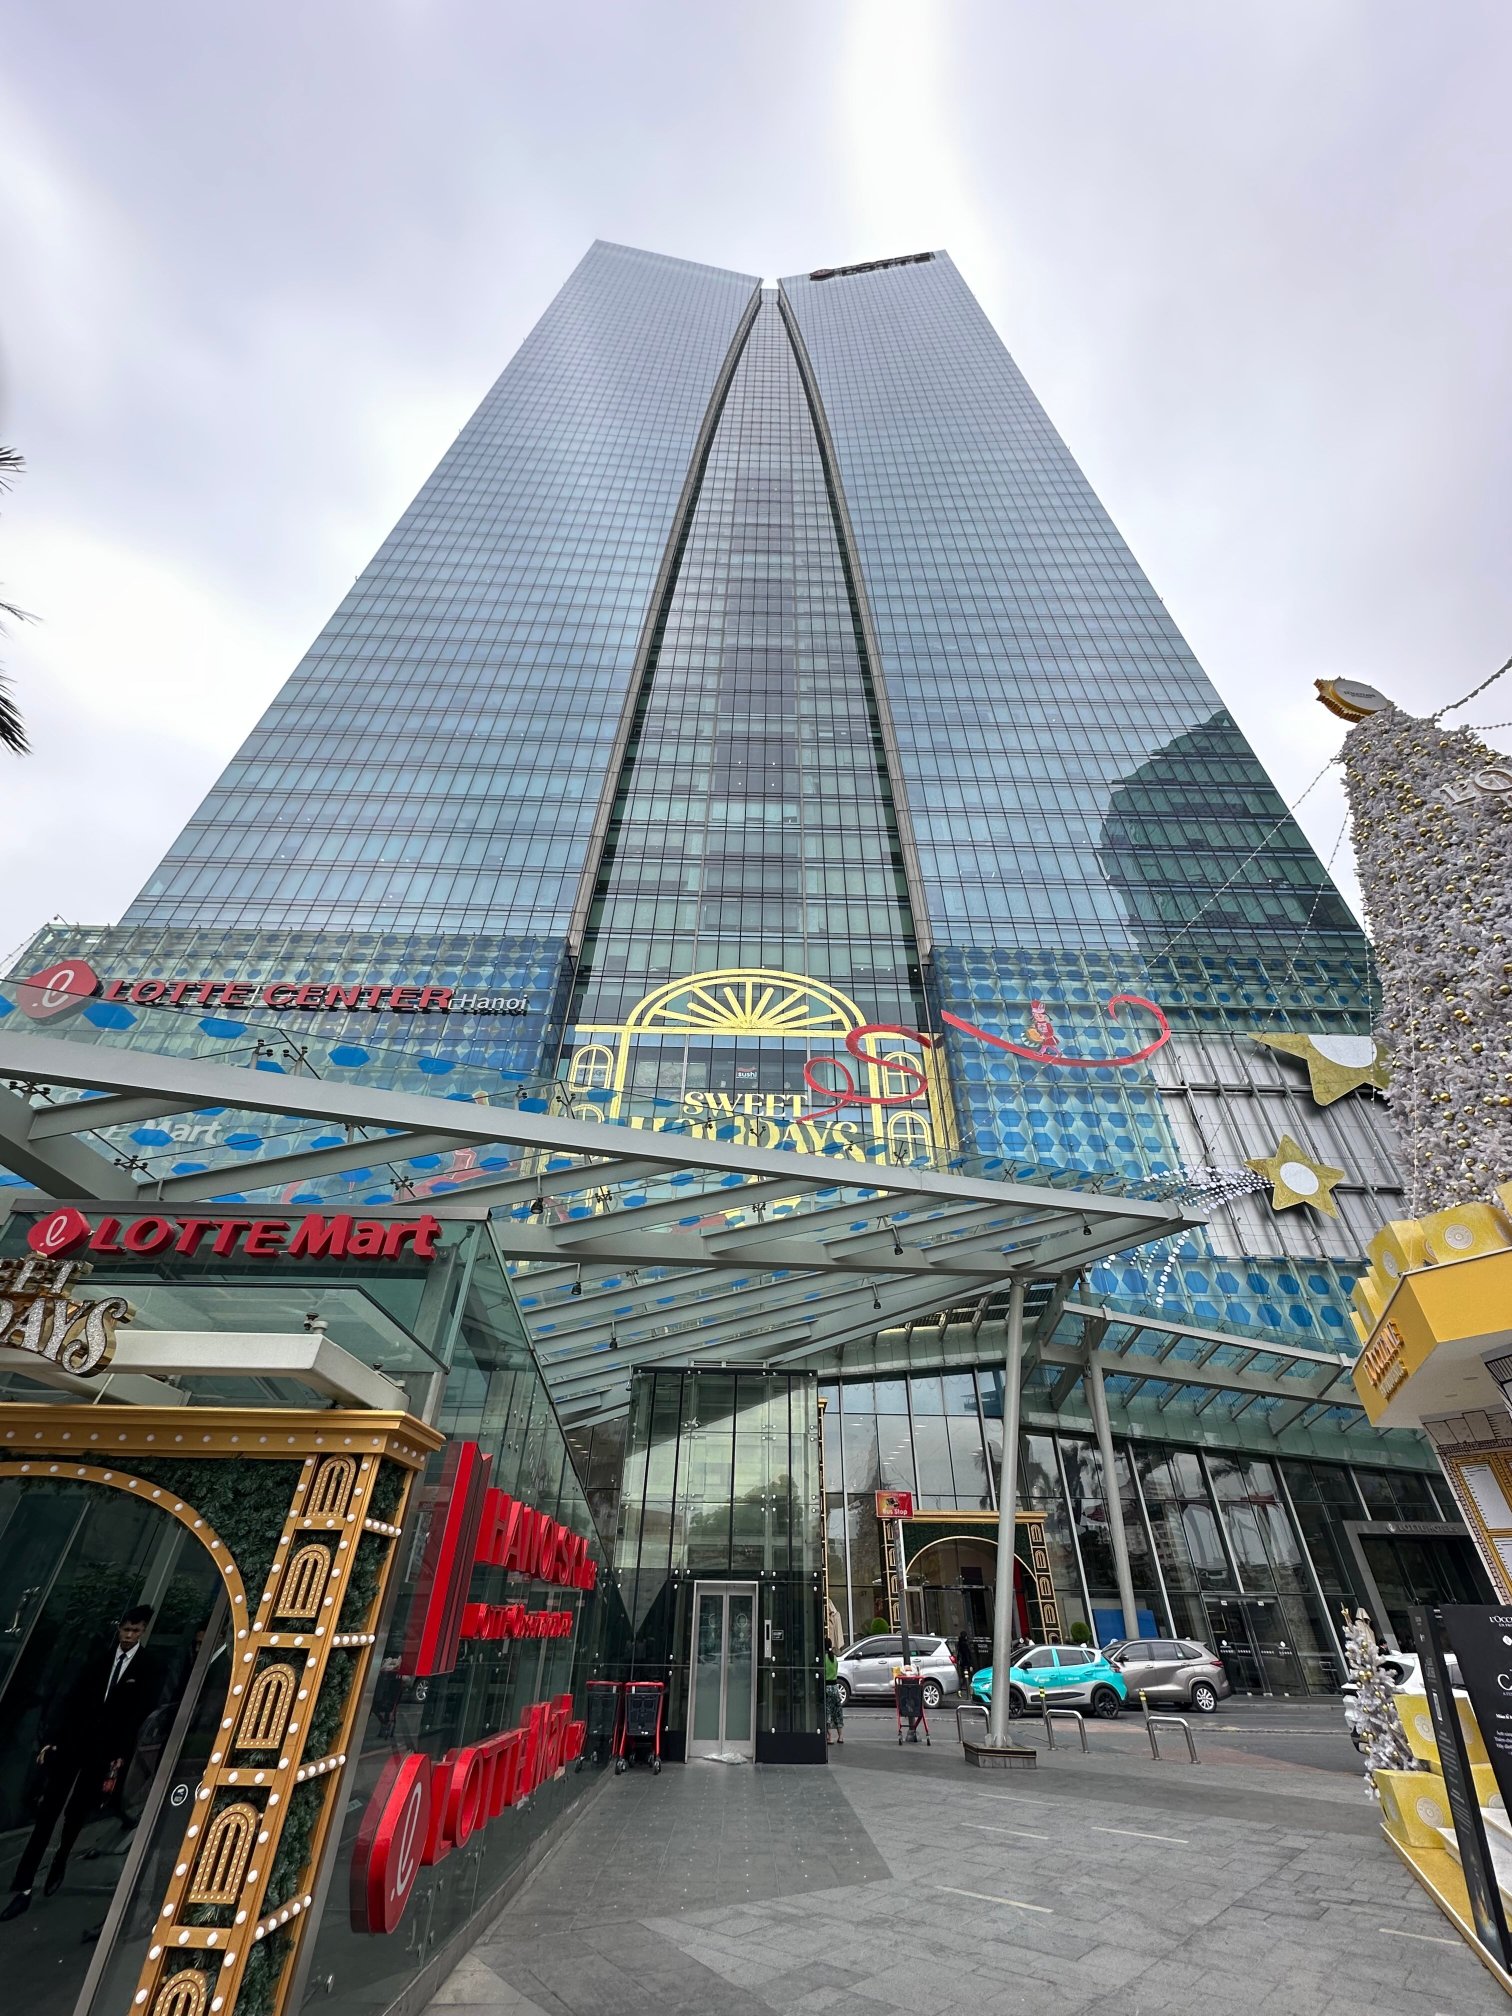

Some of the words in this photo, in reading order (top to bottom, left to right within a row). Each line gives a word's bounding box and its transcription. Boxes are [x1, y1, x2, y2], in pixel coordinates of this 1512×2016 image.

[103, 979, 252, 1006] LOTTE
[262, 983, 455, 1010] CENTER
[460, 993, 528, 1013] Hanoi
[683, 1091, 808, 1118] SWEET
[88, 1216, 291, 1258] LOTTE
[288, 1213, 442, 1262] Mart
[0, 1297, 131, 1377] AYS
[894, 1508, 908, 1516] Stop
